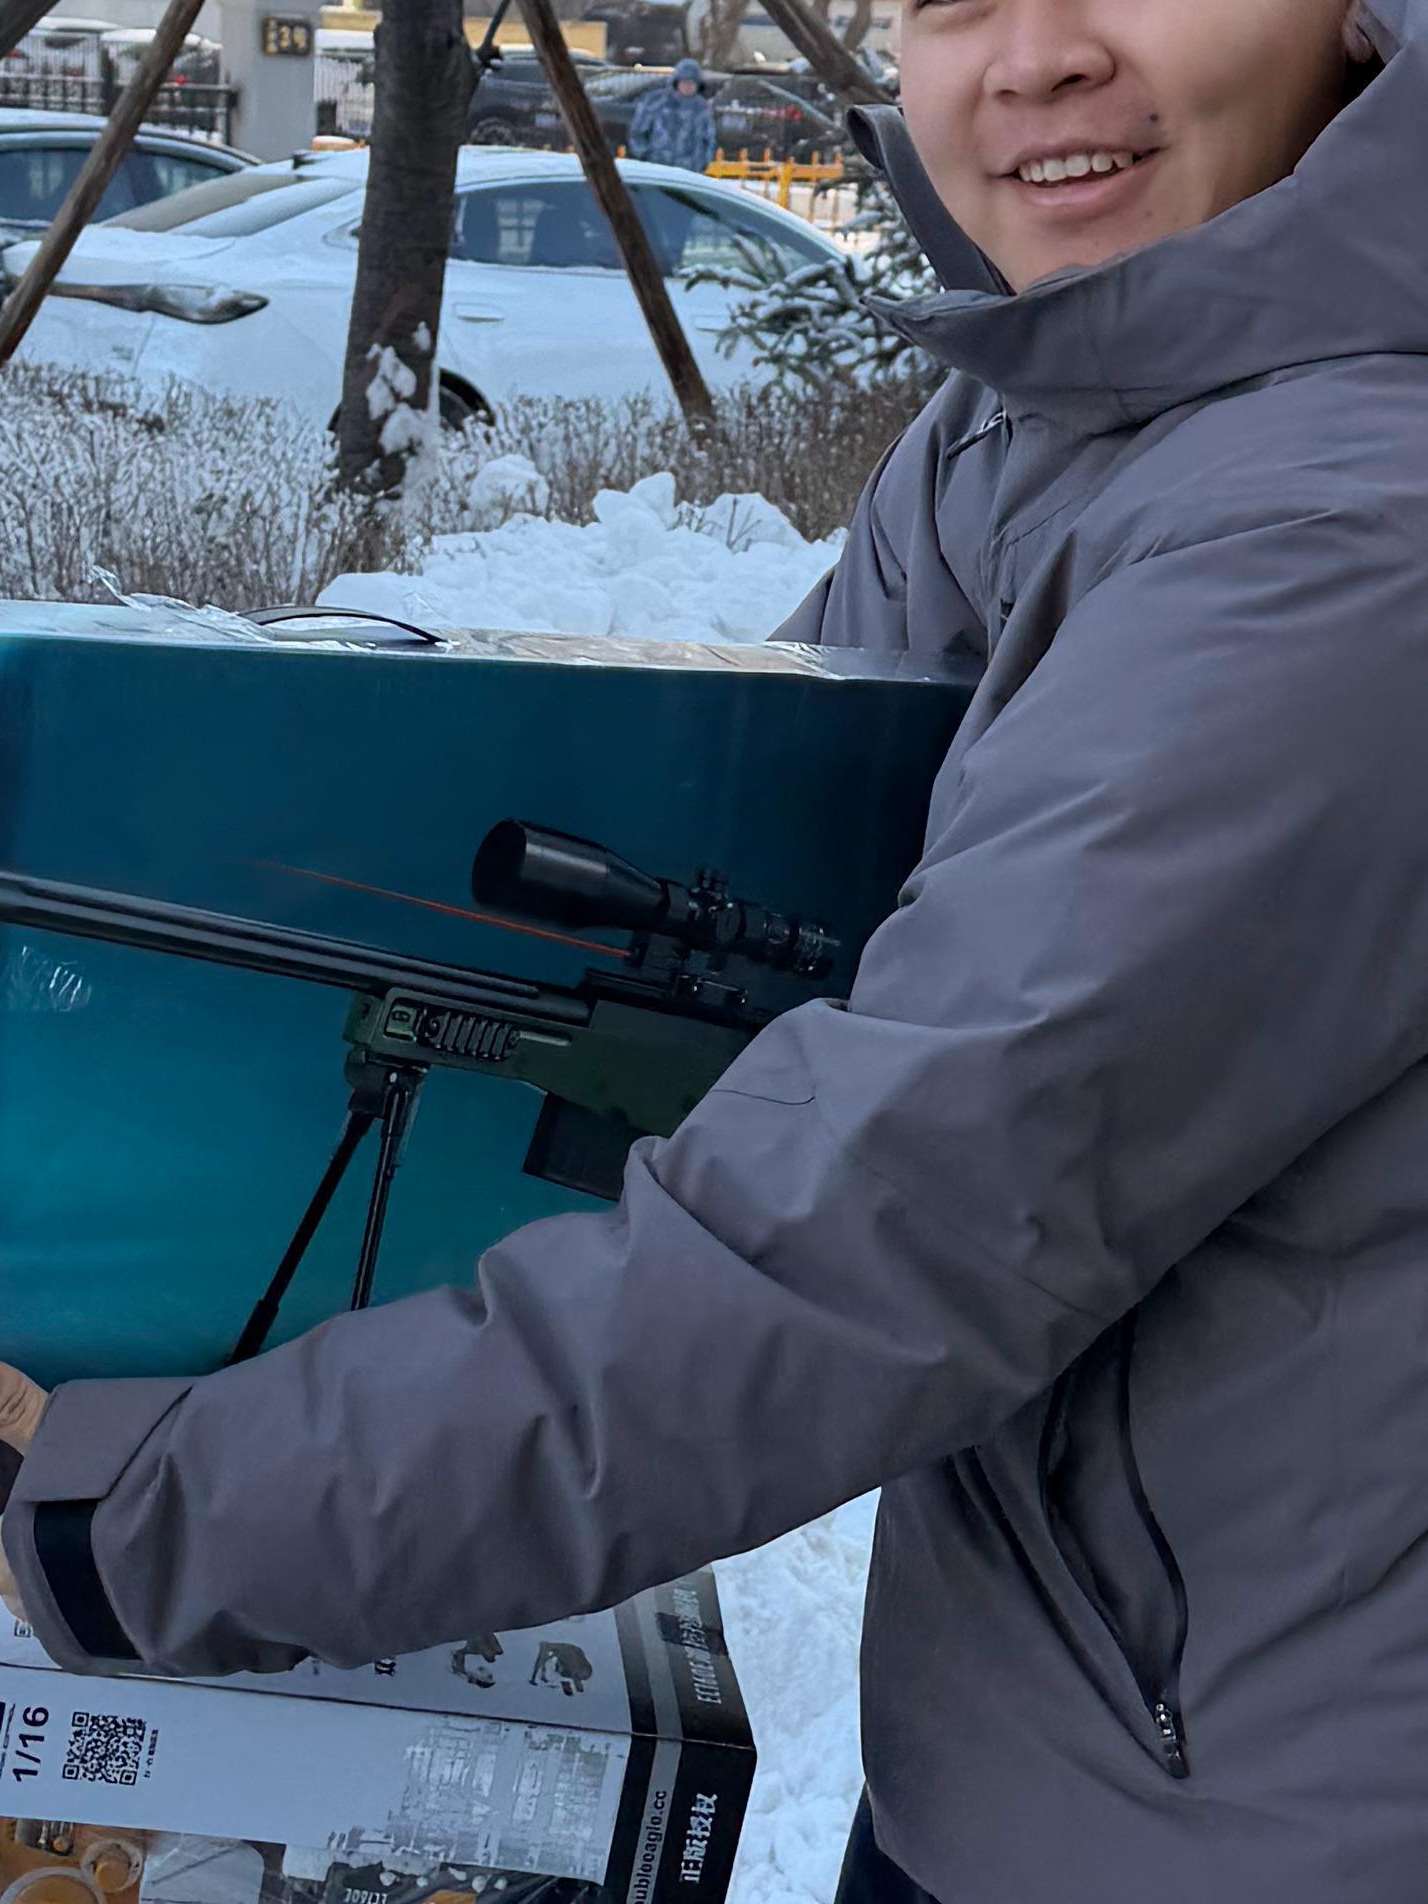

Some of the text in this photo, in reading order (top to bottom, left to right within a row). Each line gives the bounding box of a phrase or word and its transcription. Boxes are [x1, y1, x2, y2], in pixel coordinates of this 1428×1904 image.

[12, 1706, 50, 1782] 1/16
[679, 1793, 719, 1884] 正版授权
